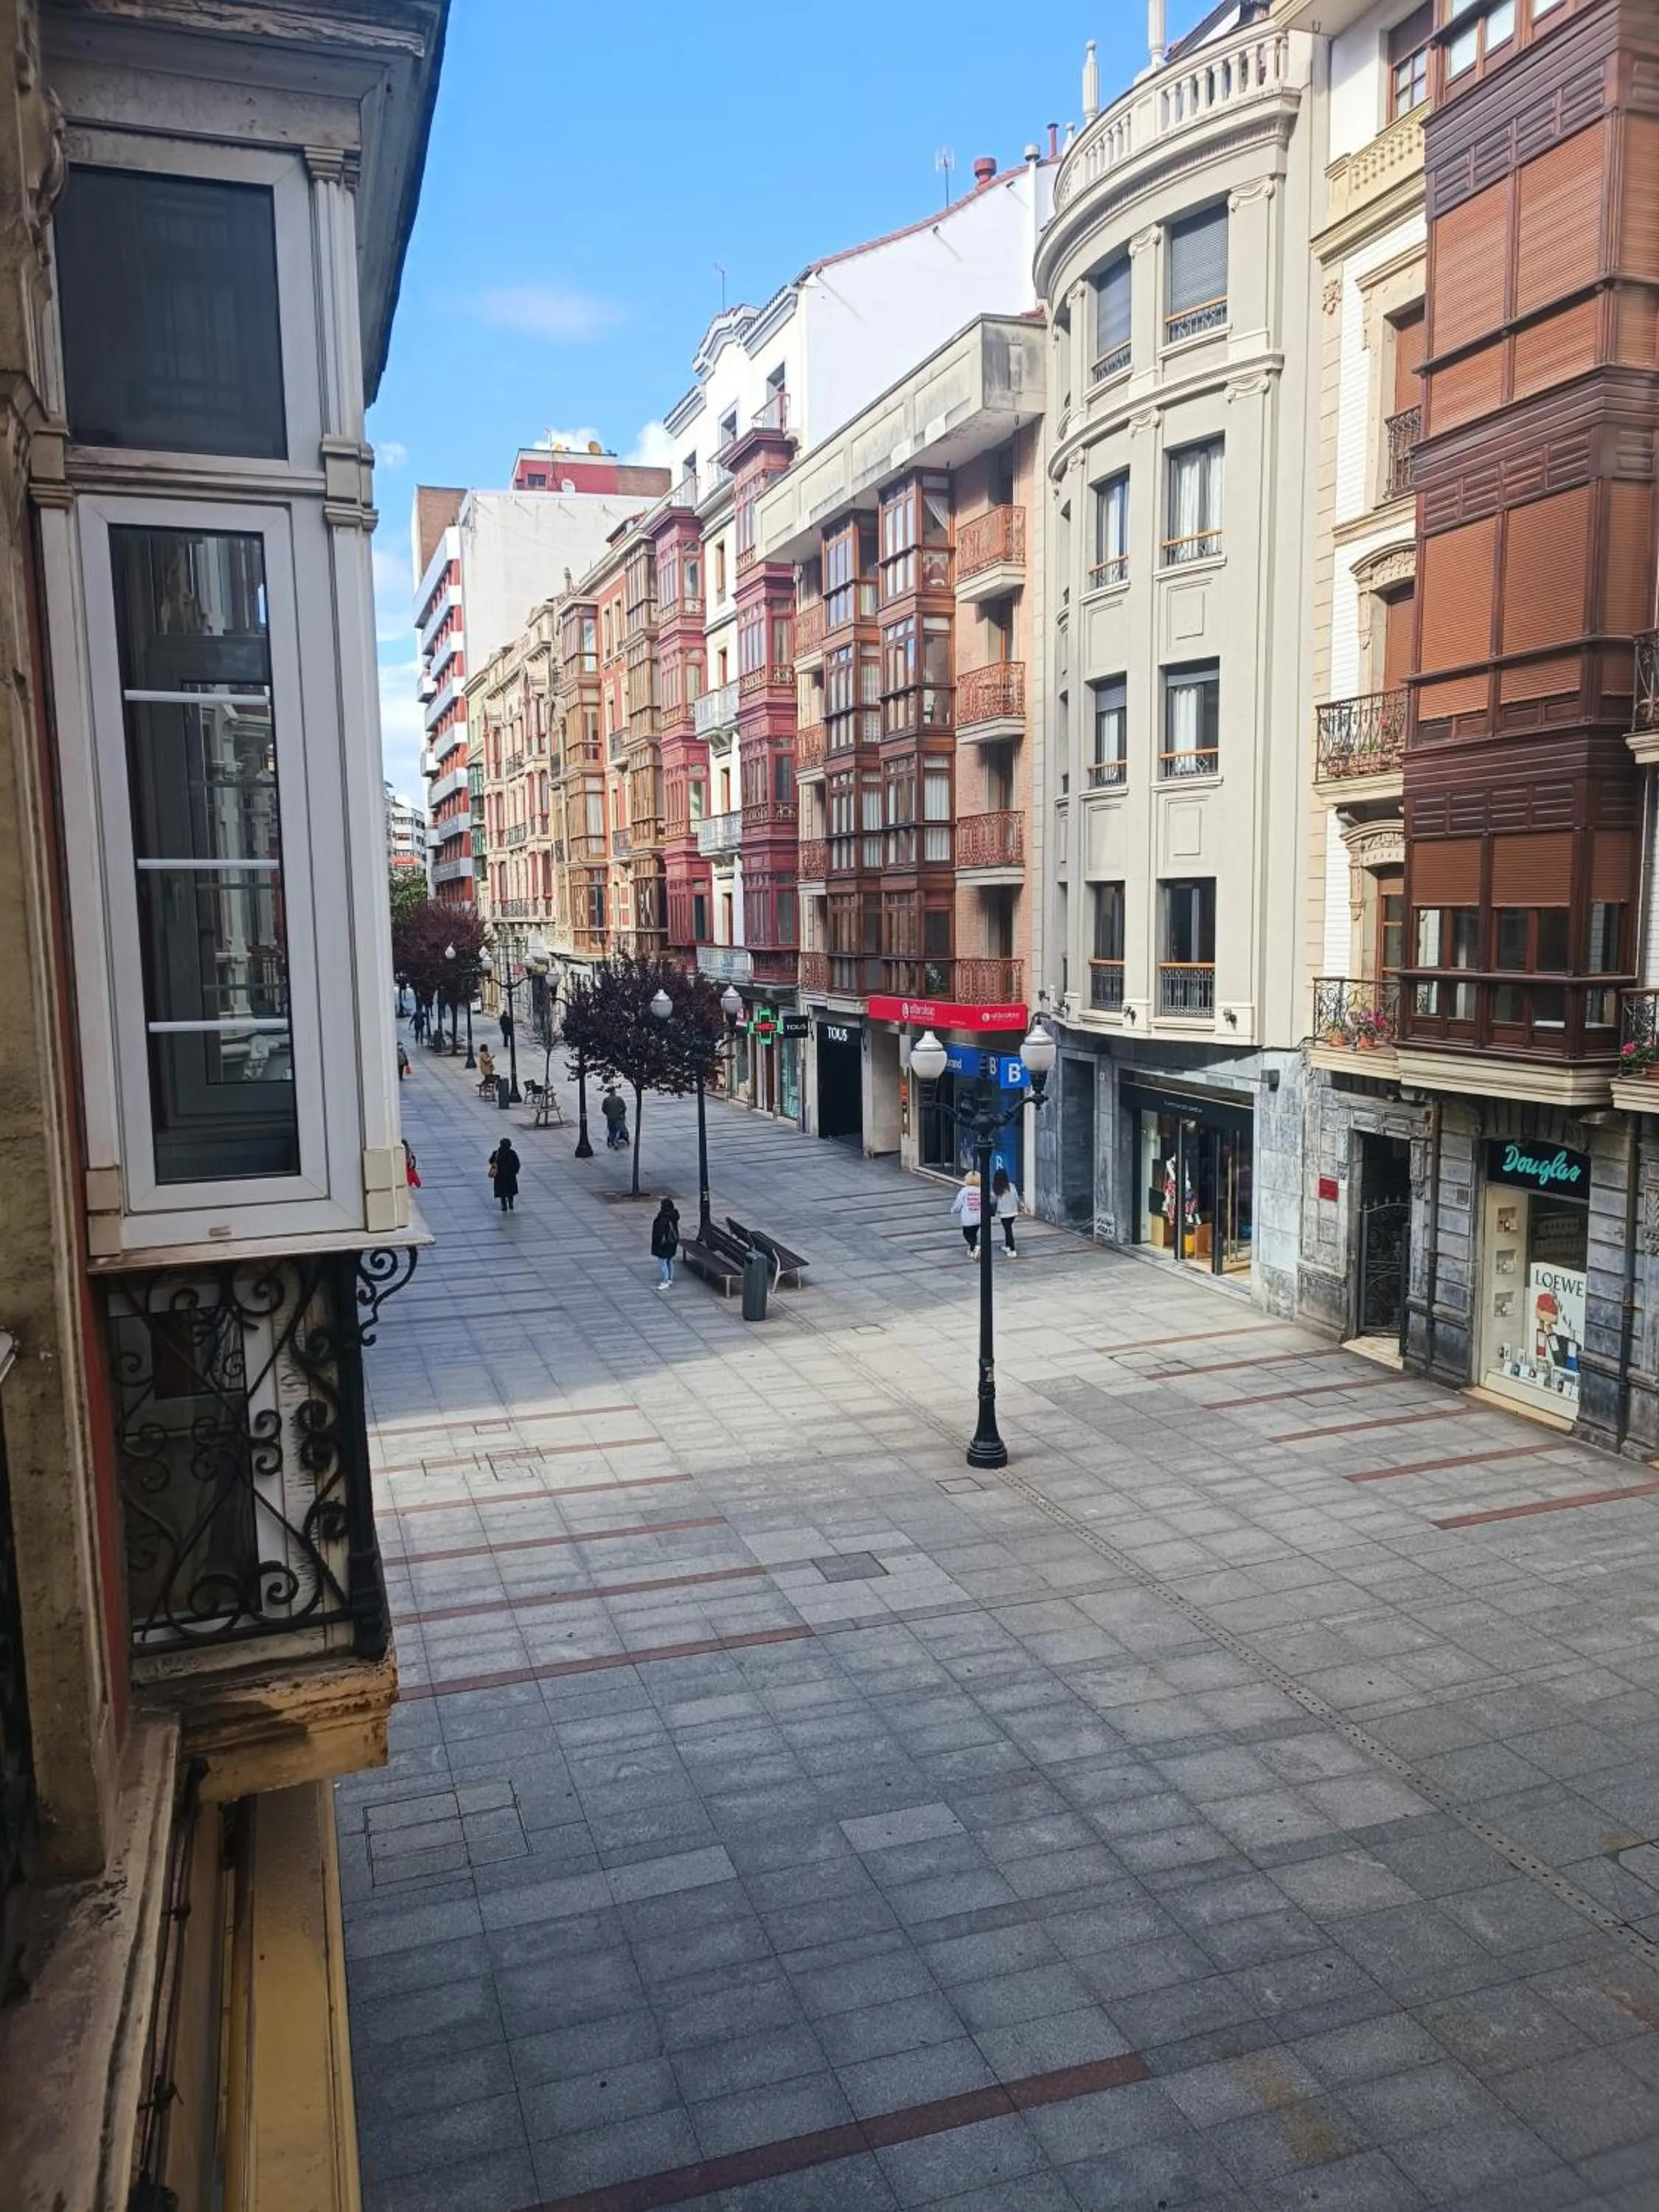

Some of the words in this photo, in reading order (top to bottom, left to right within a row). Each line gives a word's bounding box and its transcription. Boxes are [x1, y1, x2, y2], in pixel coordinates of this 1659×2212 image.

[786, 1023, 807, 1031] TOUS
[827, 1026, 848, 1042] TOUS
[1008, 1062, 1021, 1083] B
[1502, 1144, 1582, 1186] Douglas
[1535, 1269, 1584, 1298] LOEWE
